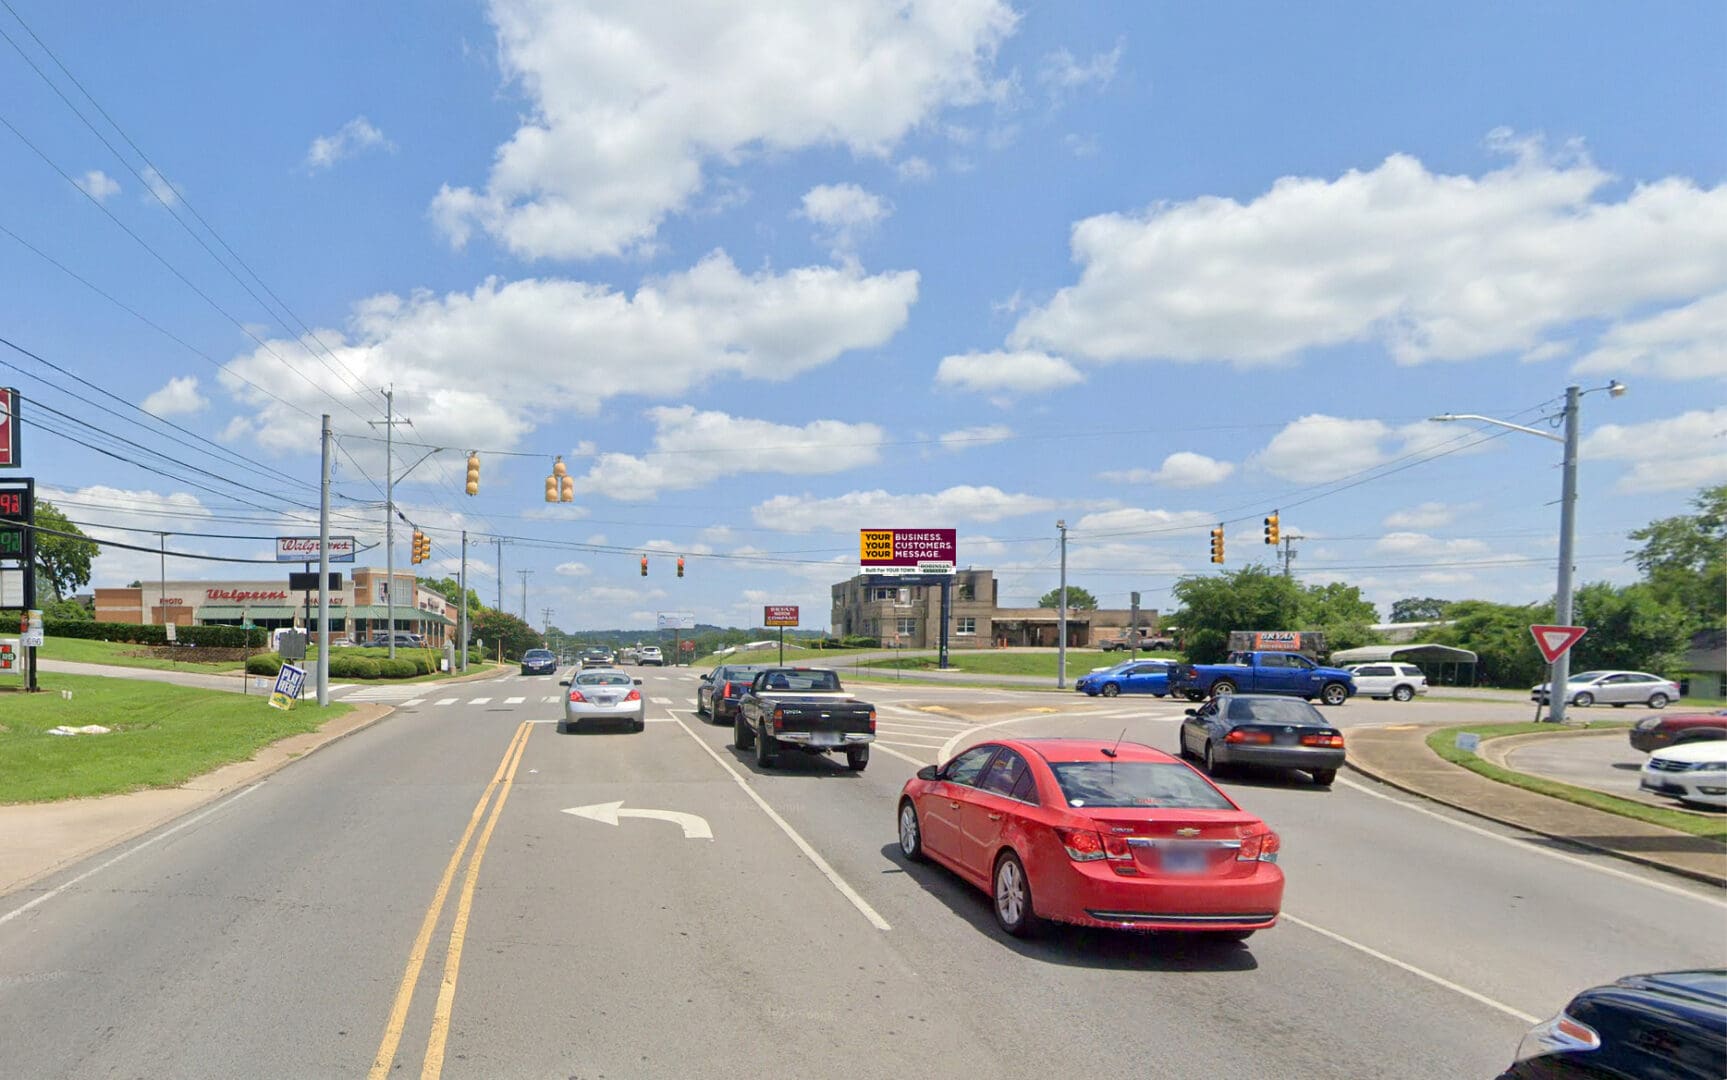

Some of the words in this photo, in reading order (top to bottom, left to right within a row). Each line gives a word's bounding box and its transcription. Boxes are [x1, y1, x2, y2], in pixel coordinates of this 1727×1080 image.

[895, 533, 943, 541] BUSINESS.
[895, 550, 941, 558] MESSAGE.
[206, 589, 288, 603] Walgreens
